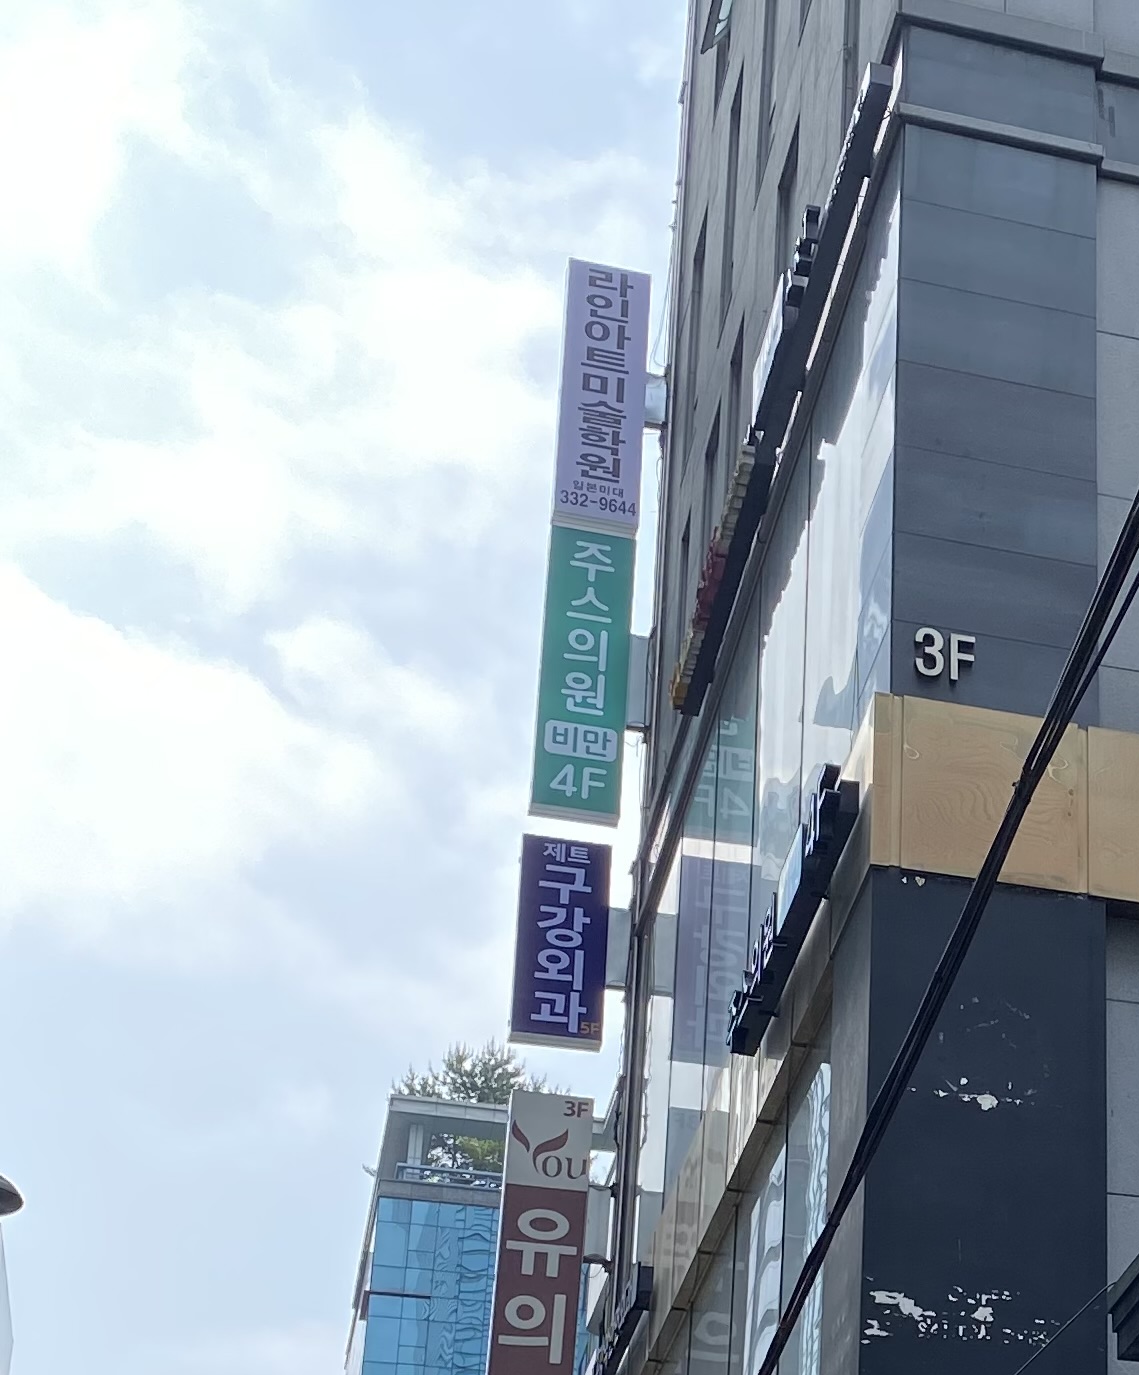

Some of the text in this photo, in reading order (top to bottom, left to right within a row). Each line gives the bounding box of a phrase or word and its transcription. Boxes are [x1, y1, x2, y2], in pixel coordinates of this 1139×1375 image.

[576, 268, 634, 484] 라인아트미술학원
[560, 489, 637, 516] 332-9644
[561, 540, 615, 716] 주스의원
[914, 627, 976, 681] 3F
[551, 725, 612, 758] 비만
[549, 763, 607, 799] 4F
[542, 842, 591, 864] 제트
[530, 864, 592, 1033] 구강외과
[580, 1021, 600, 1035] 5F
[563, 1100, 589, 1119] 3F
